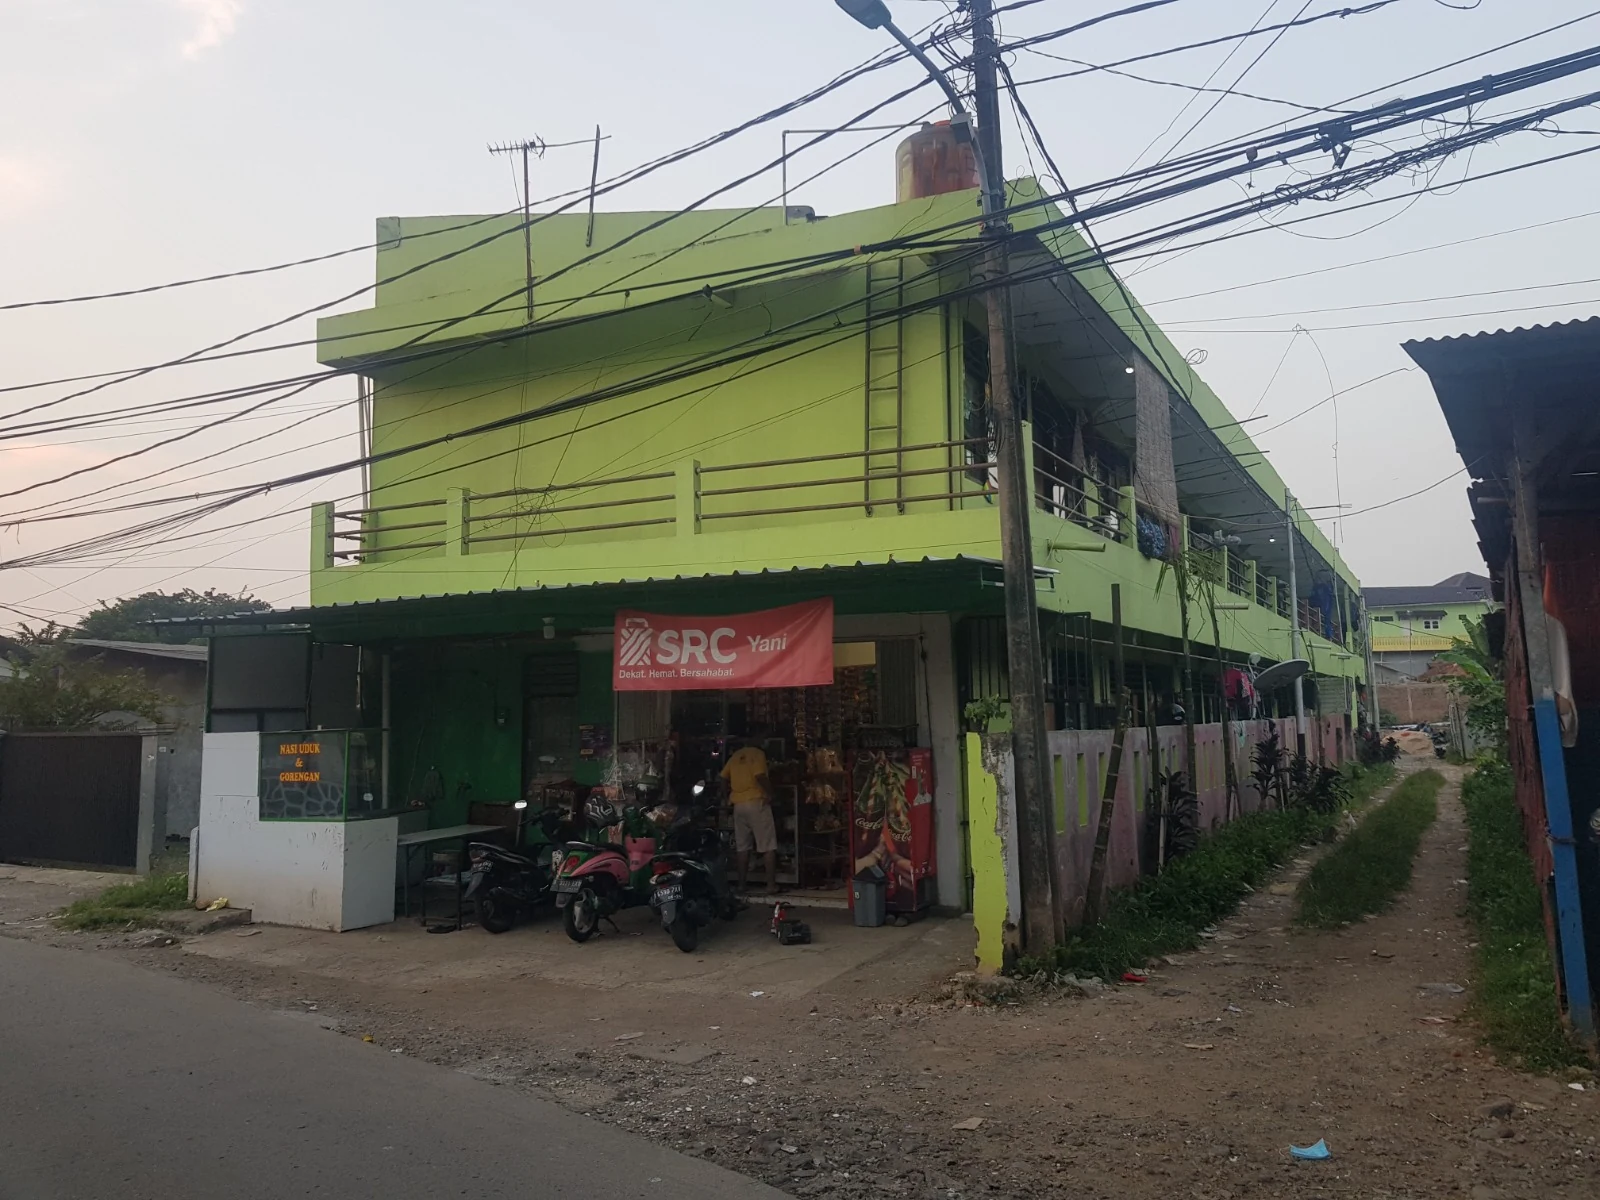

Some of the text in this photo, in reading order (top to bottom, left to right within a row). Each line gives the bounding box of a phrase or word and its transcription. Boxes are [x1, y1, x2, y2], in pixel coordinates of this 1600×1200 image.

[656, 627, 788, 664] SRC Yani
[619, 668, 736, 679] Dekat. Hemat. Bersahabat.
[280, 743, 320, 755] NASI UDUK
[295, 757, 303, 767] &
[280, 772, 320, 782] GORENGAN
